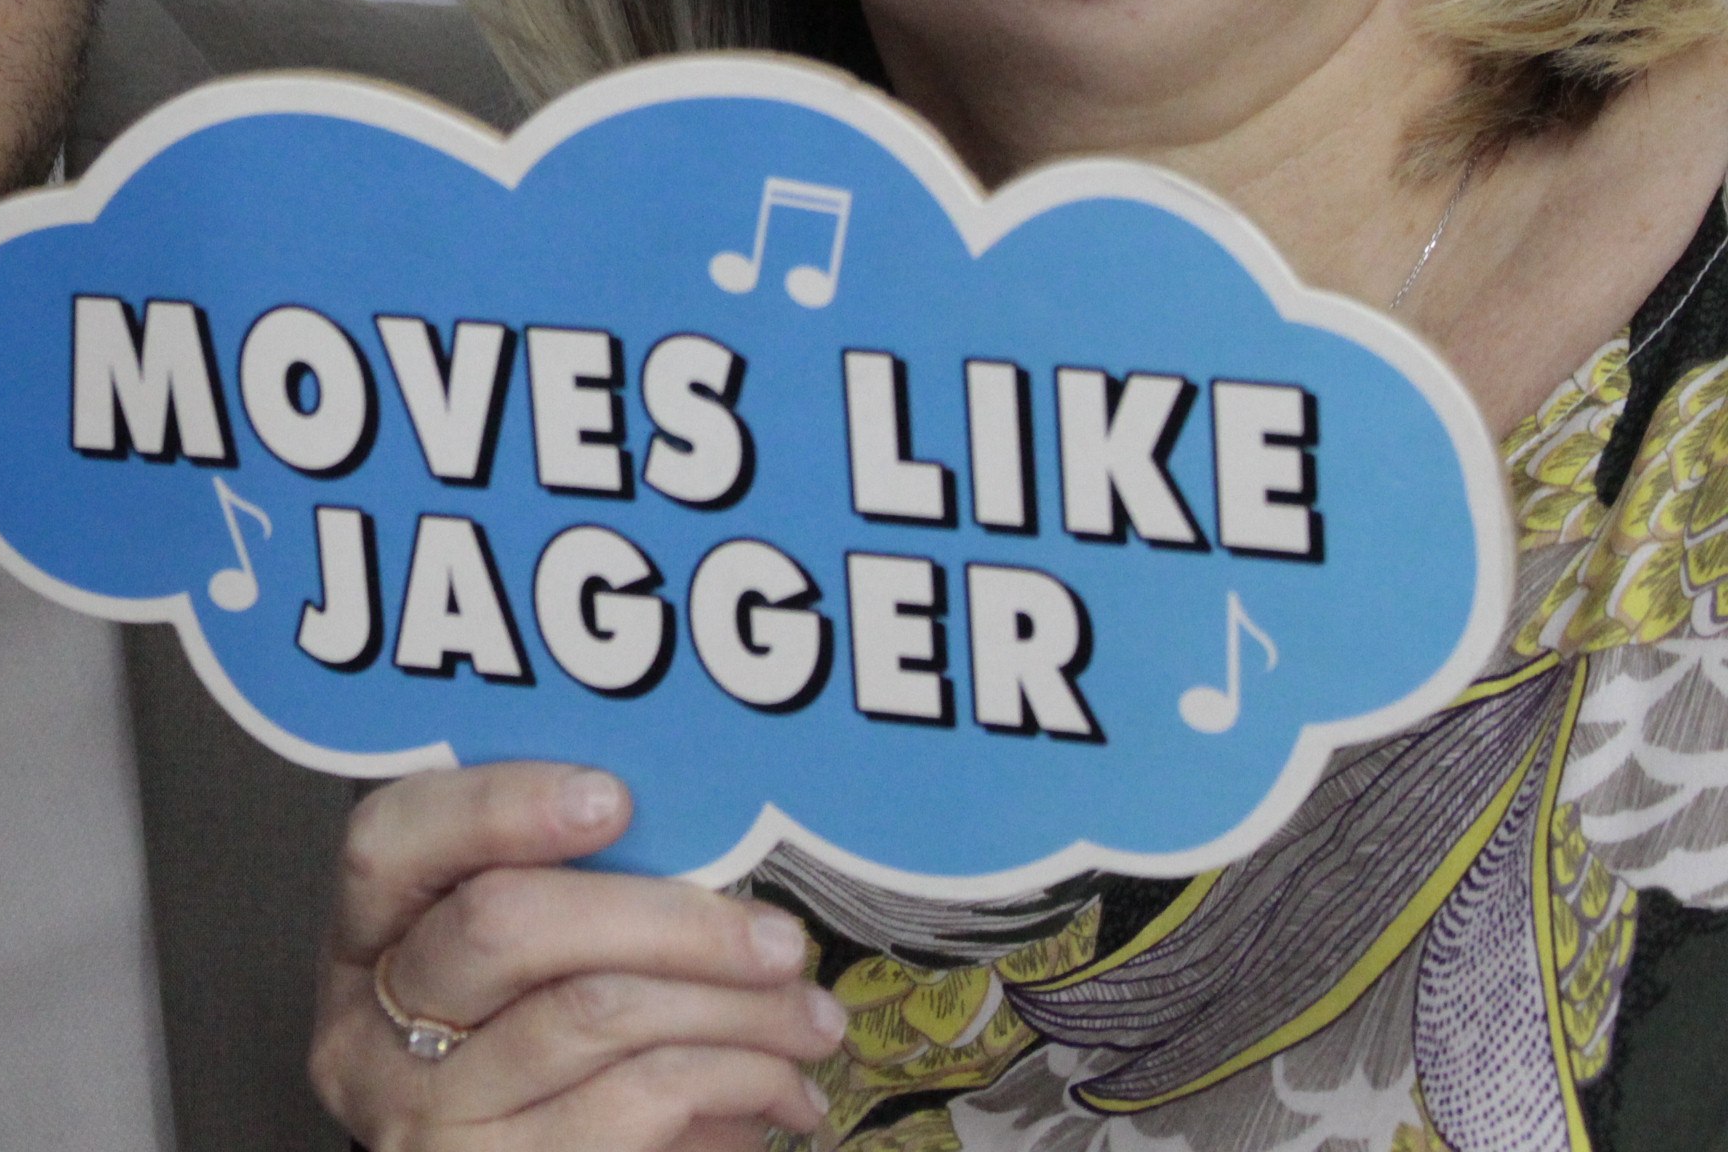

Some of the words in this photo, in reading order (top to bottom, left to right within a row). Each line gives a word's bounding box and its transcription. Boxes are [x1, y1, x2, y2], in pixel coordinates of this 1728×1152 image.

[72, 294, 756, 512] MOVES
[842, 348, 1324, 563] LIKE
[296, 505, 1107, 745] JAGGER
